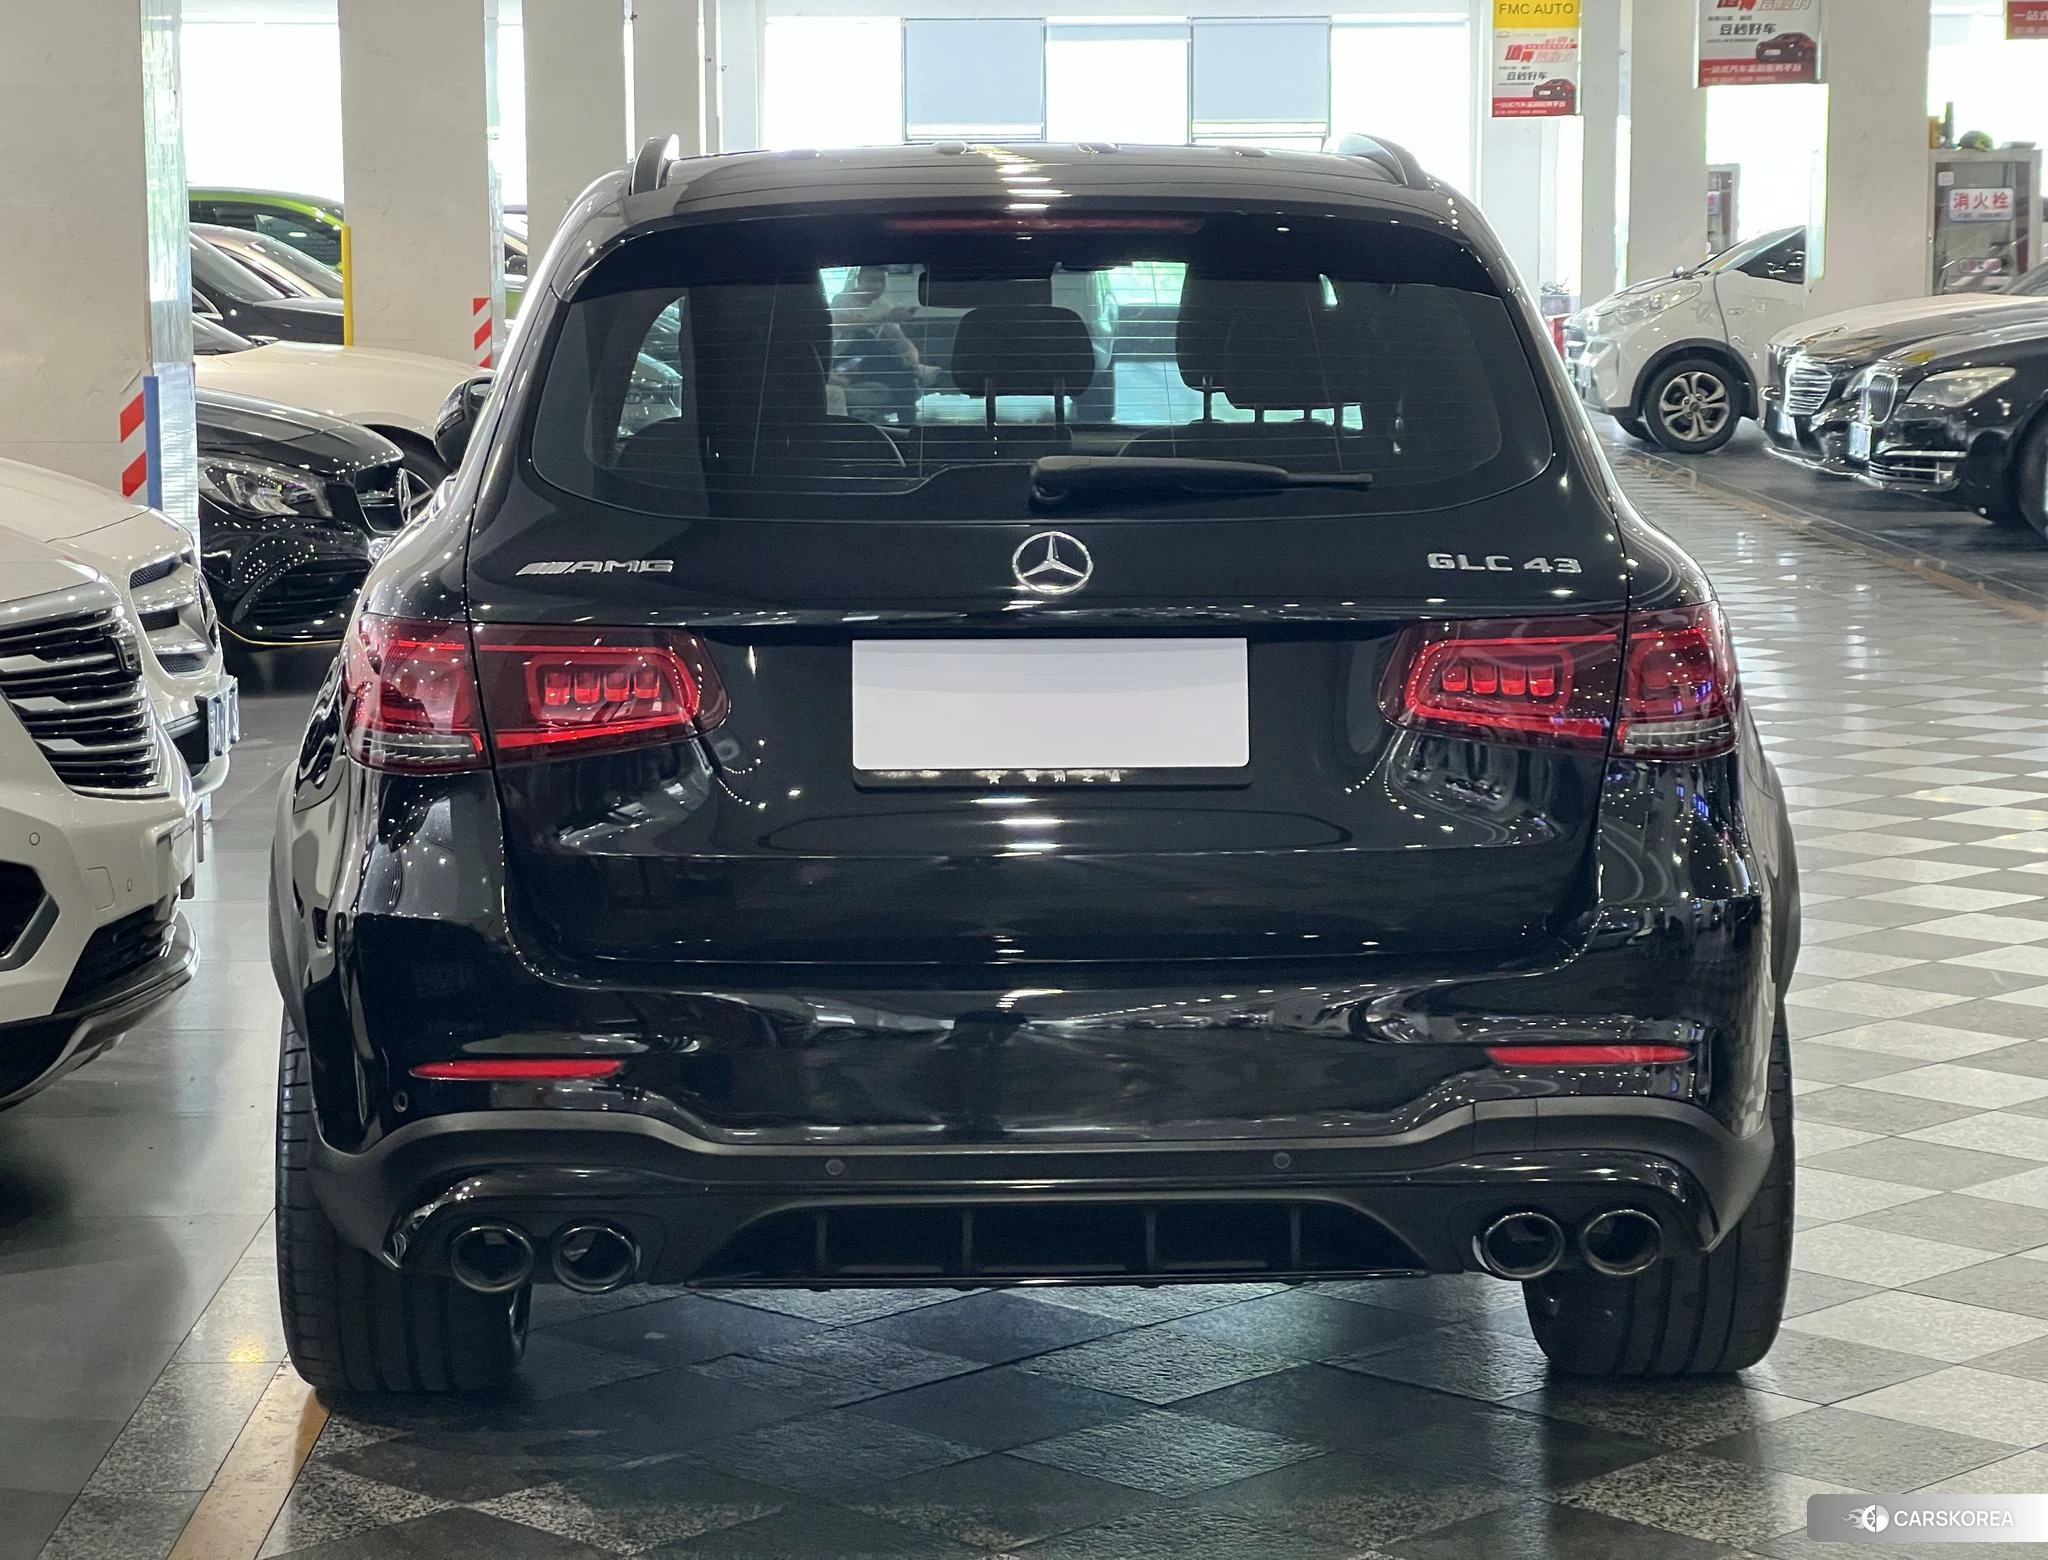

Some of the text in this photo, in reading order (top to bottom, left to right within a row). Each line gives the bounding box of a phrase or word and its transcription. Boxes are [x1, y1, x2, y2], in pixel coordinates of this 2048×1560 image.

[1499, 3, 1574, 15] FMC AUTO
[1953, 191, 2009, 210] 消火栓
[564, 560, 674, 574] AMG
[1427, 552, 1582, 573] GLC 43
